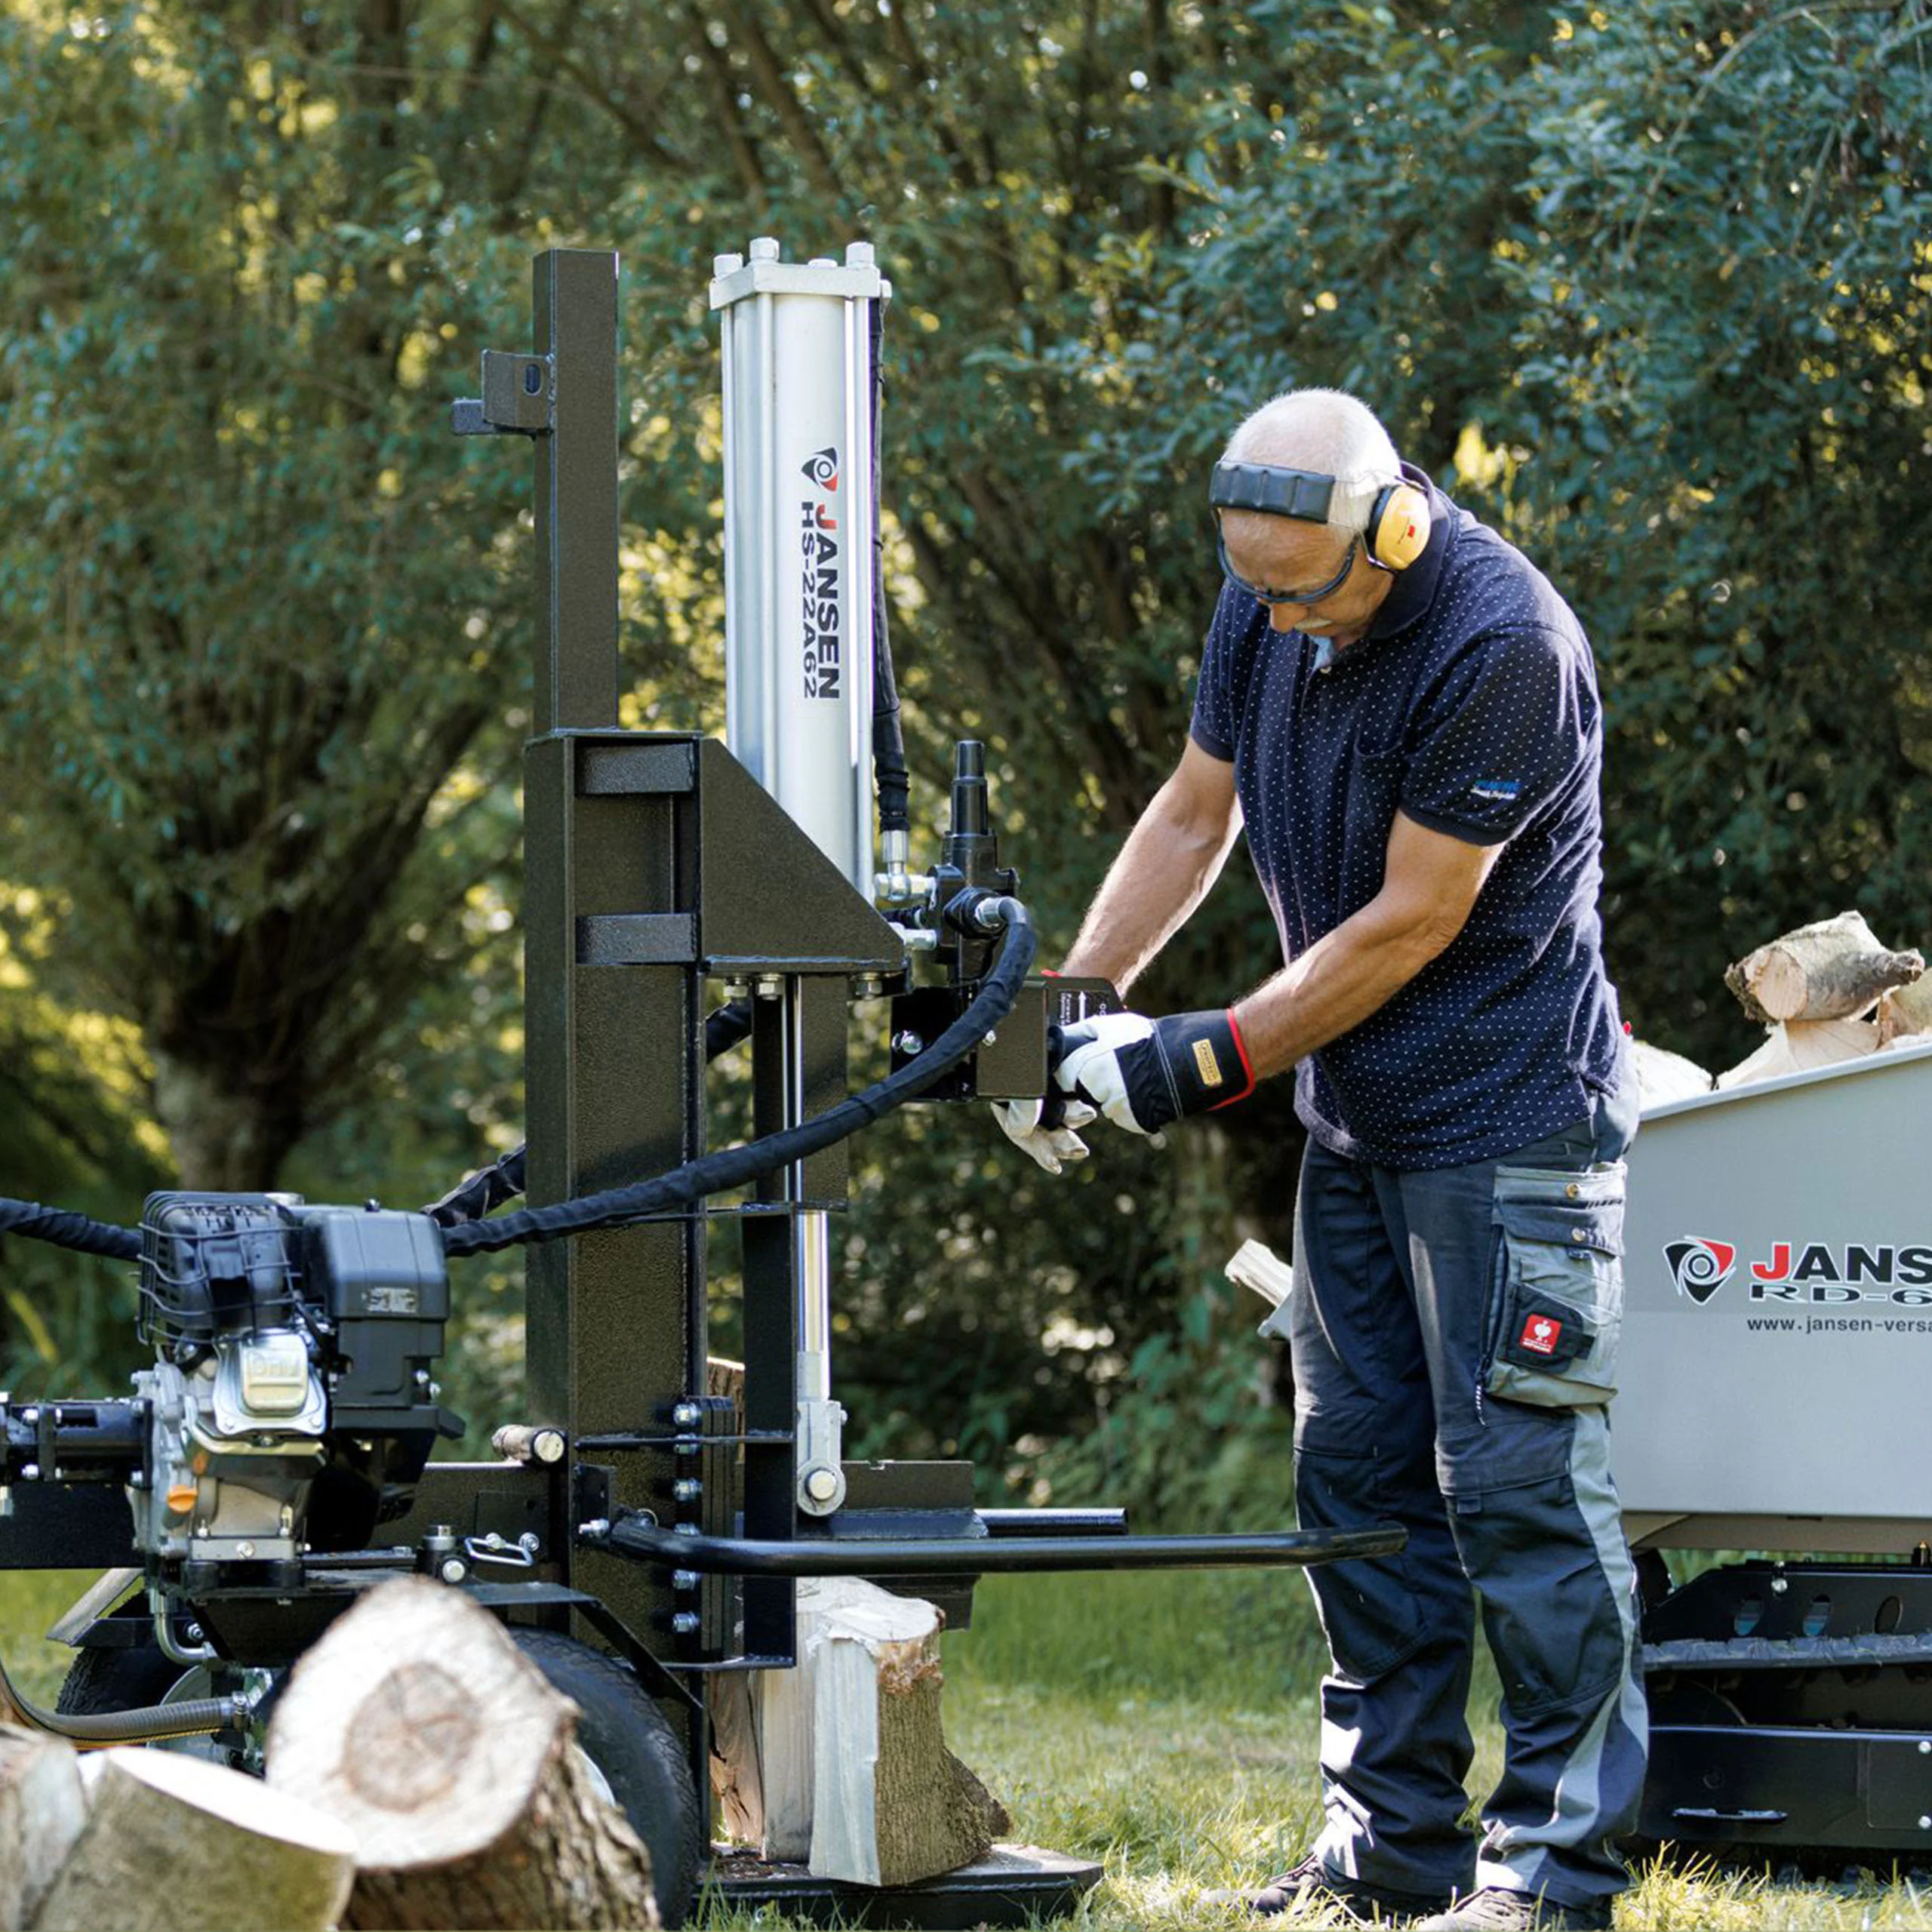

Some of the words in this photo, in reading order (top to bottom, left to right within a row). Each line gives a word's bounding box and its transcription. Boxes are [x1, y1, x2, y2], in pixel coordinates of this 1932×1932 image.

[801, 501, 817, 699] HS-22A62
[815, 503, 840, 699] JANSEN
[1750, 1243, 1932, 1284] JANS
